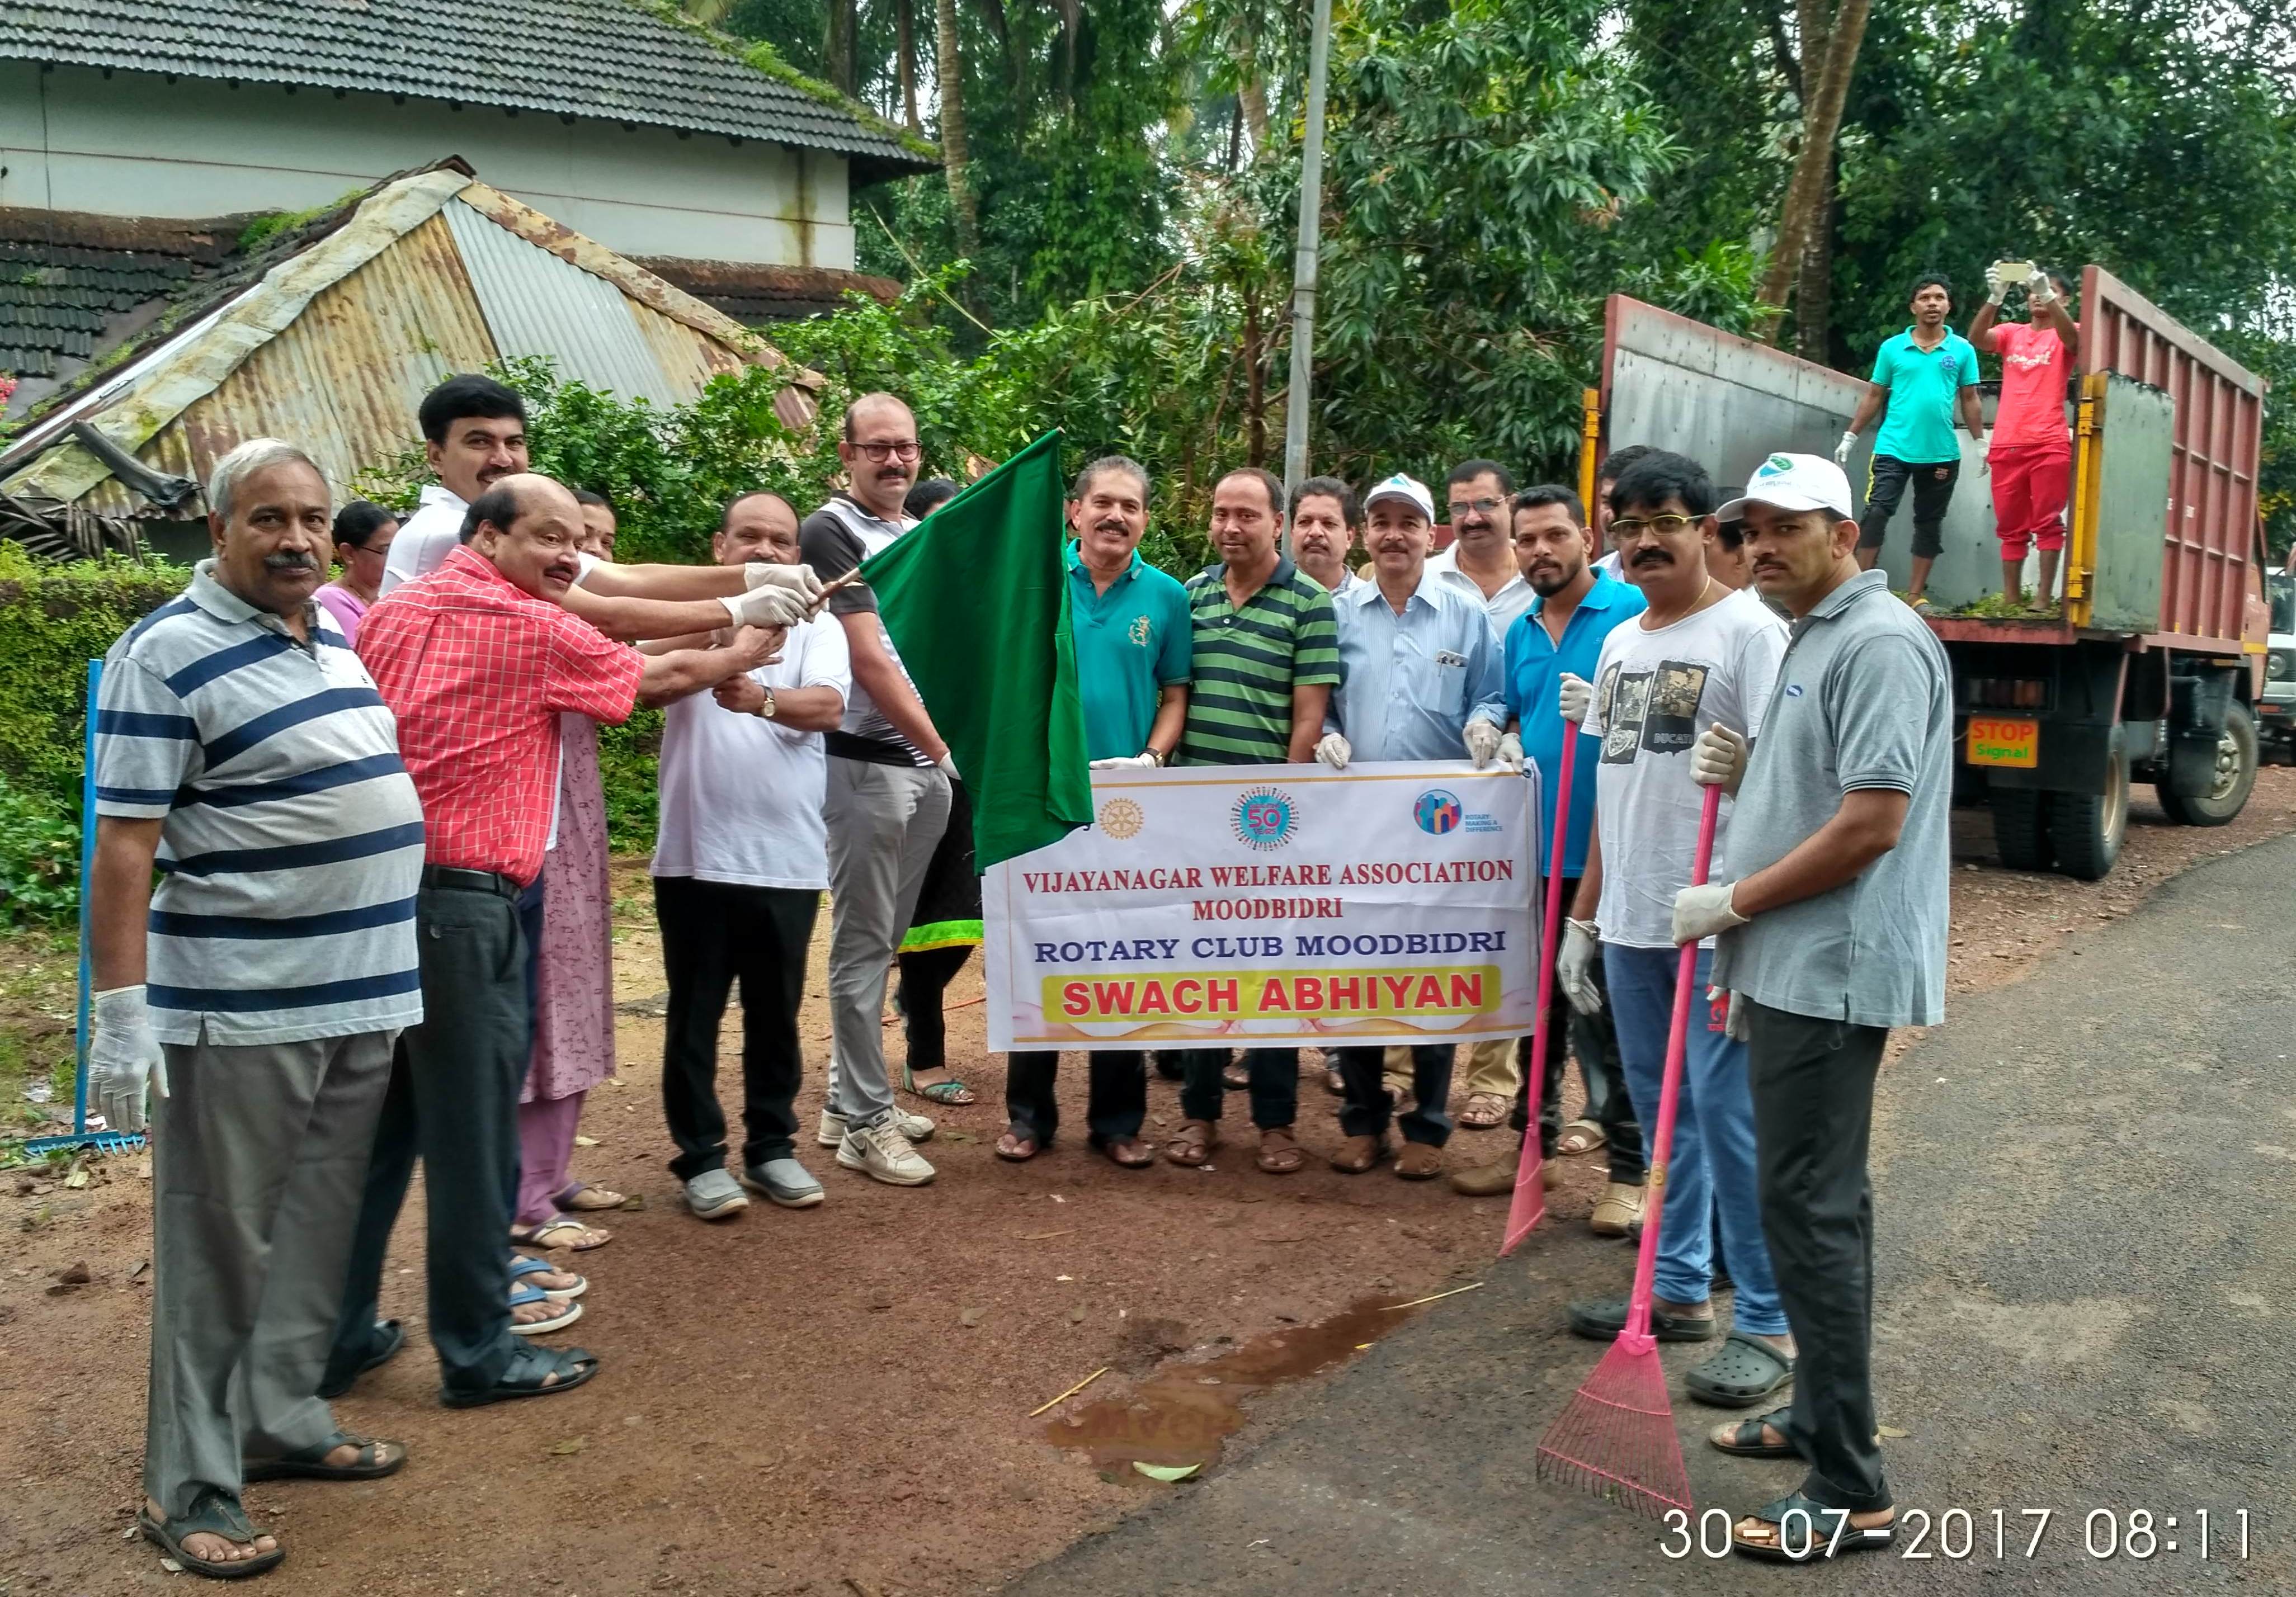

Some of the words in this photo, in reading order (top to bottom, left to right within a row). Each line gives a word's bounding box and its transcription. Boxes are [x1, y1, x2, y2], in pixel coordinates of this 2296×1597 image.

[1653, 733, 1694, 744] DUCATI
[1972, 722, 2034, 741] STOP
[1976, 744, 2029, 760] Signal
[1248, 809, 1280, 828] 50
[1022, 867, 1203, 893] VIJAYANAGAR
[1209, 864, 1331, 887] WELFARE
[1338, 859, 1514, 885] ASSOCIATION
[1192, 897, 1343, 920] MOODBIDRI
[1034, 939, 1180, 962] ROTARY
[1191, 936, 1284, 958] CLUB
[1295, 930, 1506, 956] MOODBIDRI
[1064, 979, 1238, 1015] SWACH
[1259, 975, 1482, 1012] ABHIYAN
